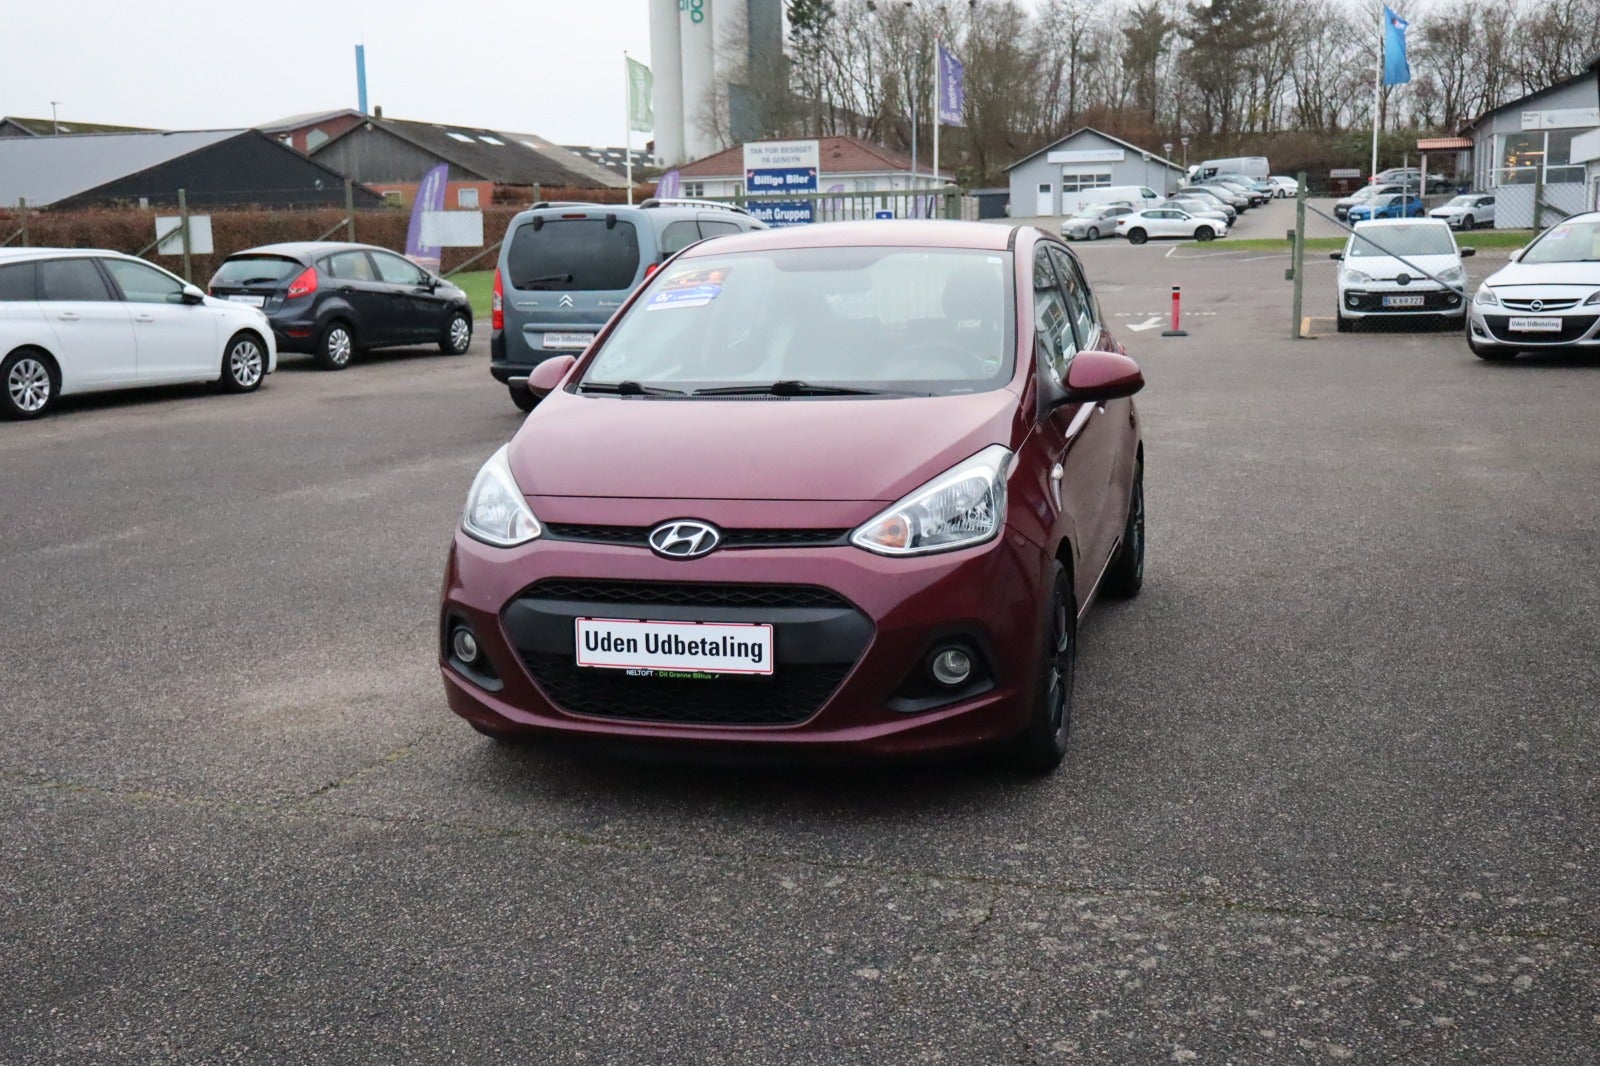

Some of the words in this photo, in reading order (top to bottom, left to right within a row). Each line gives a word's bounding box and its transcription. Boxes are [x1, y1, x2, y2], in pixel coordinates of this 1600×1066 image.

[754, 175, 784, 186] Billige
[786, 175, 809, 184] Biler
[774, 207, 810, 221] Gruppen
[585, 630, 638, 653] Uden
[645, 633, 763, 663] Udbetaling
[626, 669, 654, 677] NELTOFT
